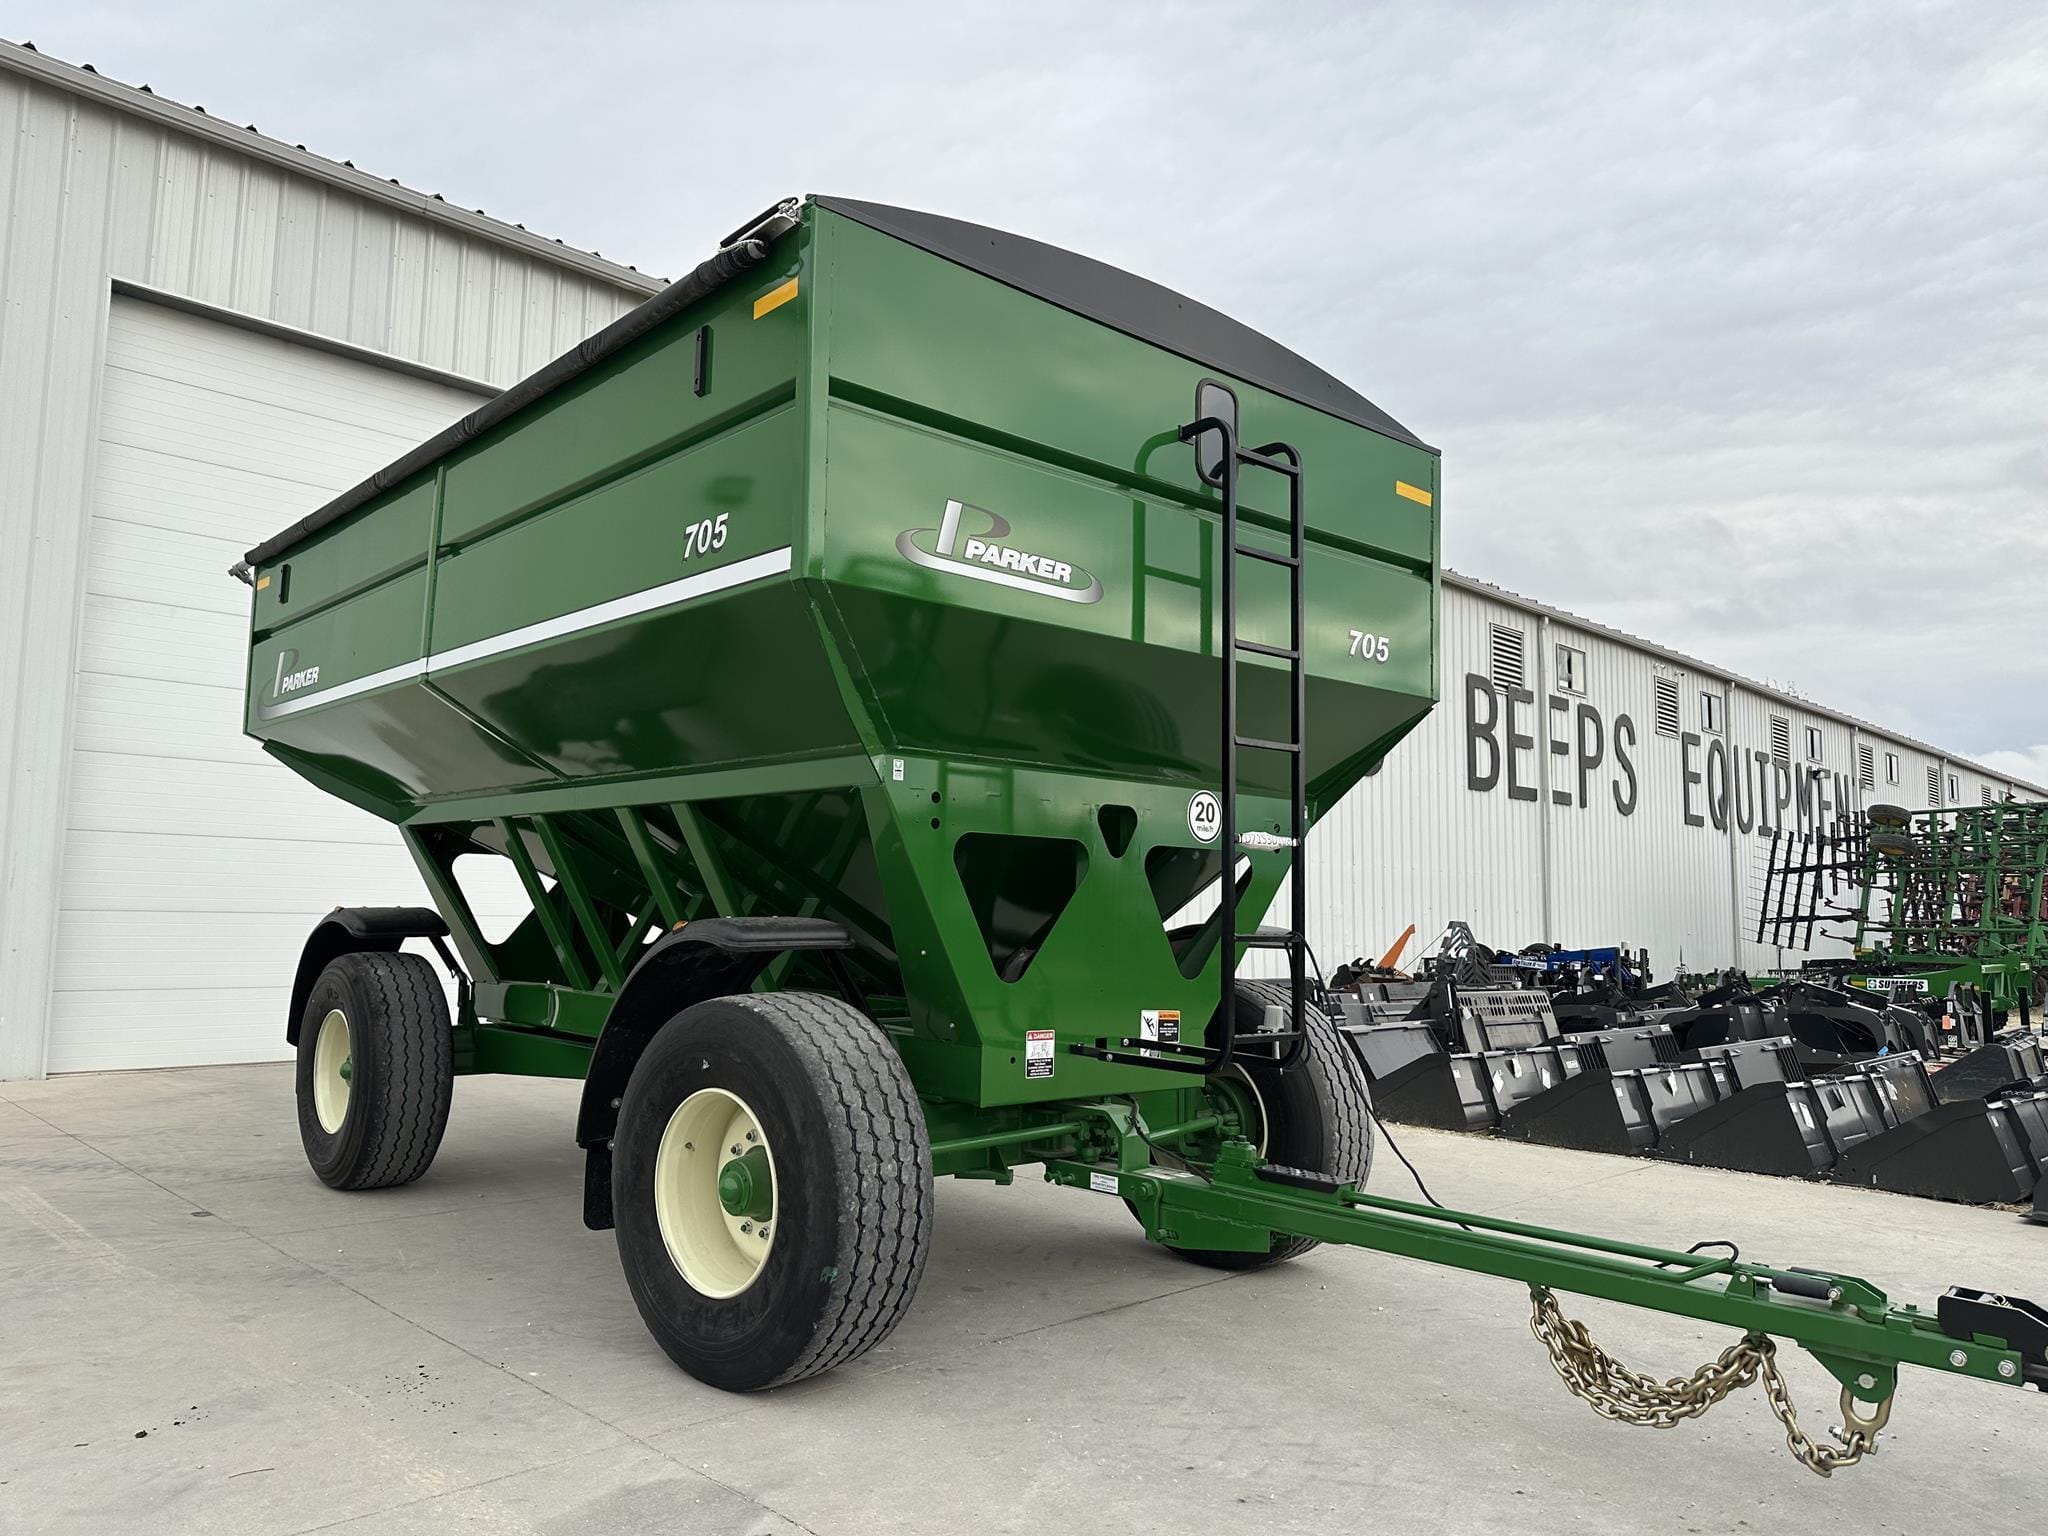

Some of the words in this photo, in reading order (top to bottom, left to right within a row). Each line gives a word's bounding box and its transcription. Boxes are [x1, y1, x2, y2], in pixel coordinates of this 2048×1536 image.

[683, 511, 729, 559] 705
[964, 538, 1072, 583] PARKER
[1349, 629, 1390, 662] 705
[281, 666, 320, 694] PARKER
[1466, 672, 1637, 817] BEEPS
[1195, 801, 1215, 823] 20
